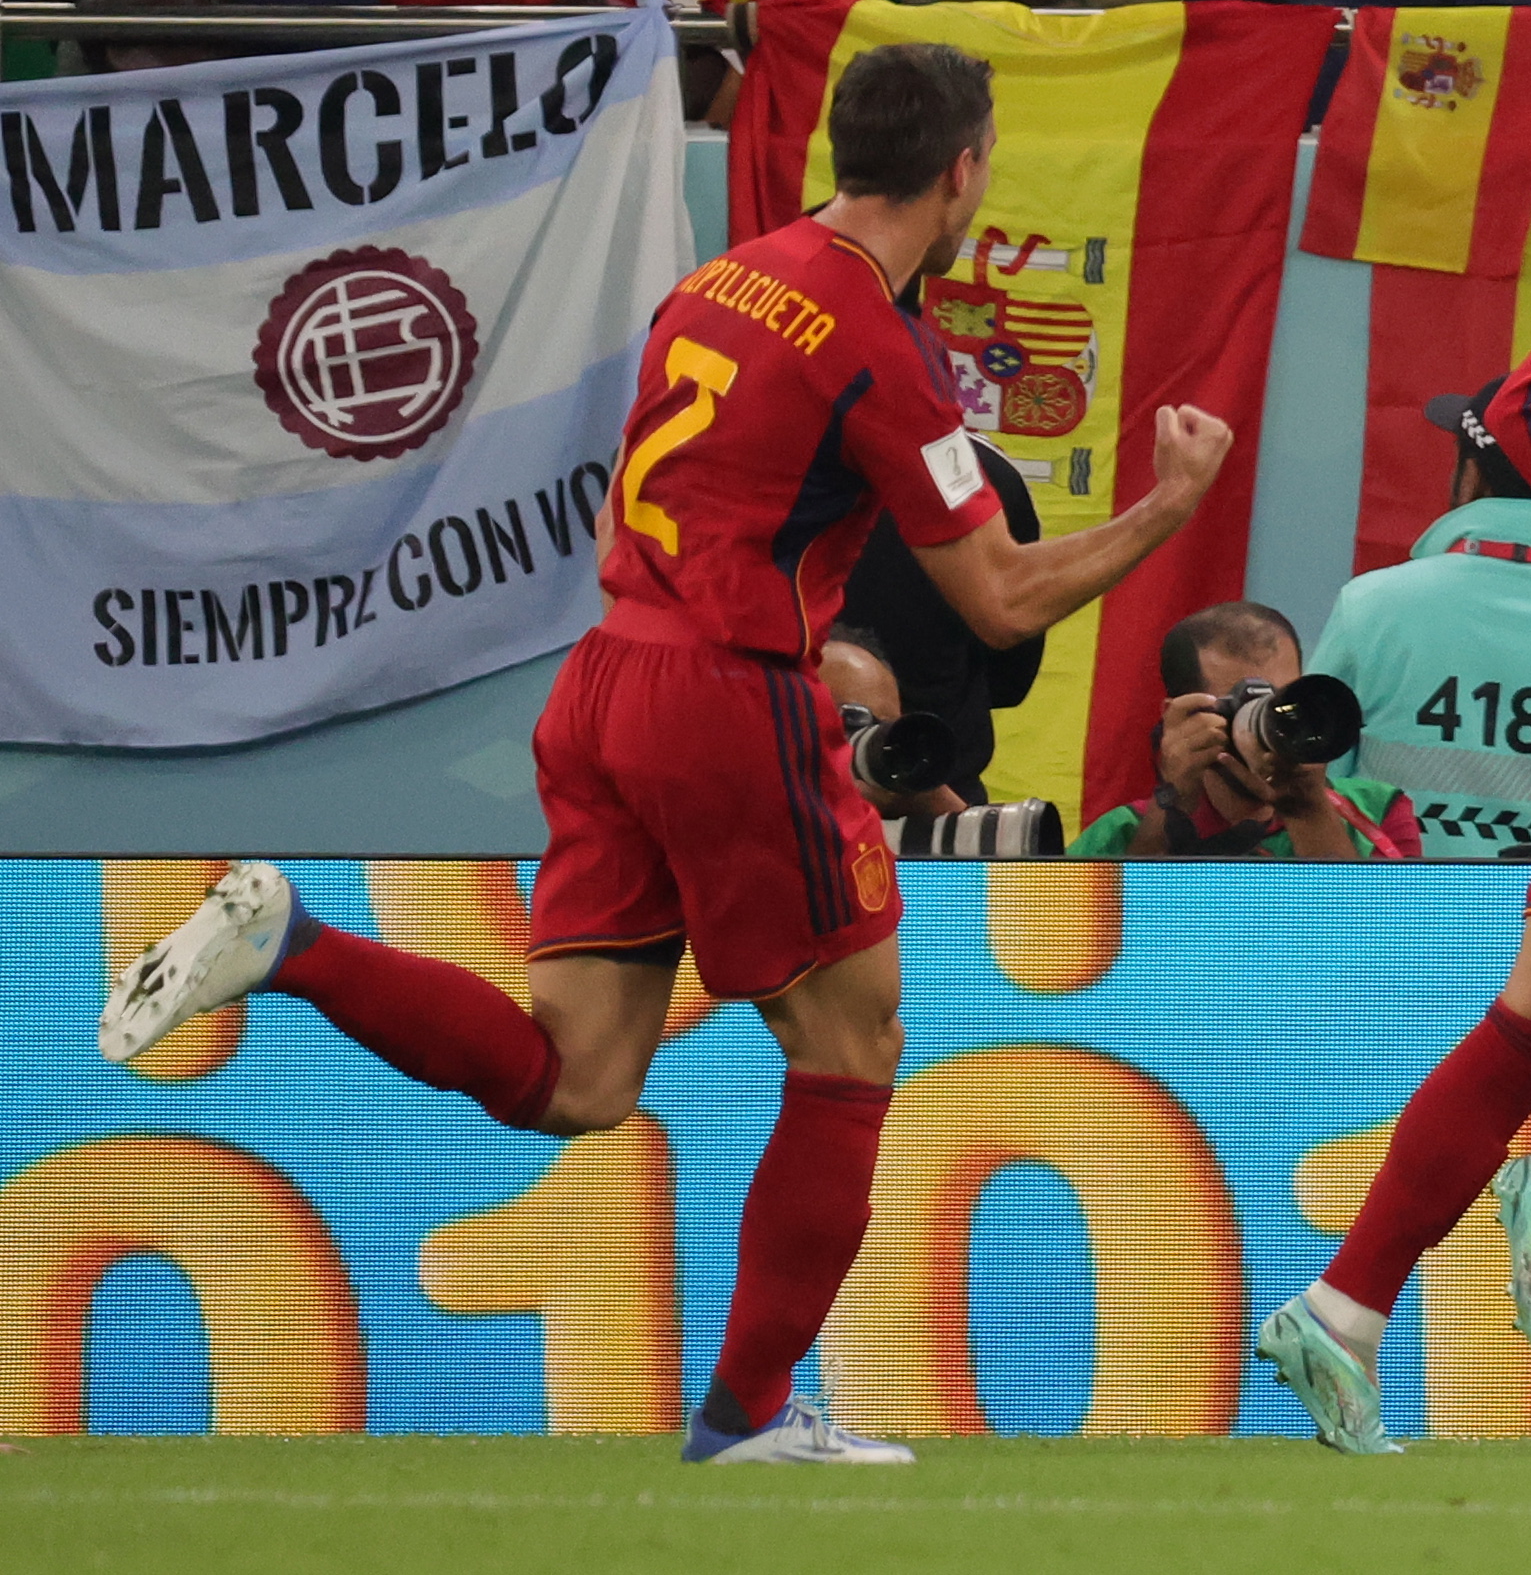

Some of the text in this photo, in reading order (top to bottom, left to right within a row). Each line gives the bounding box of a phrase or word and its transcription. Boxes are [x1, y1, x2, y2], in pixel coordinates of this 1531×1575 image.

[0, 34, 618, 233] MARCELO
[680, 257, 839, 357] PILICUETA
[386, 497, 534, 613] CON
[535, 449, 620, 558] VO
[622, 336, 740, 557] 2
